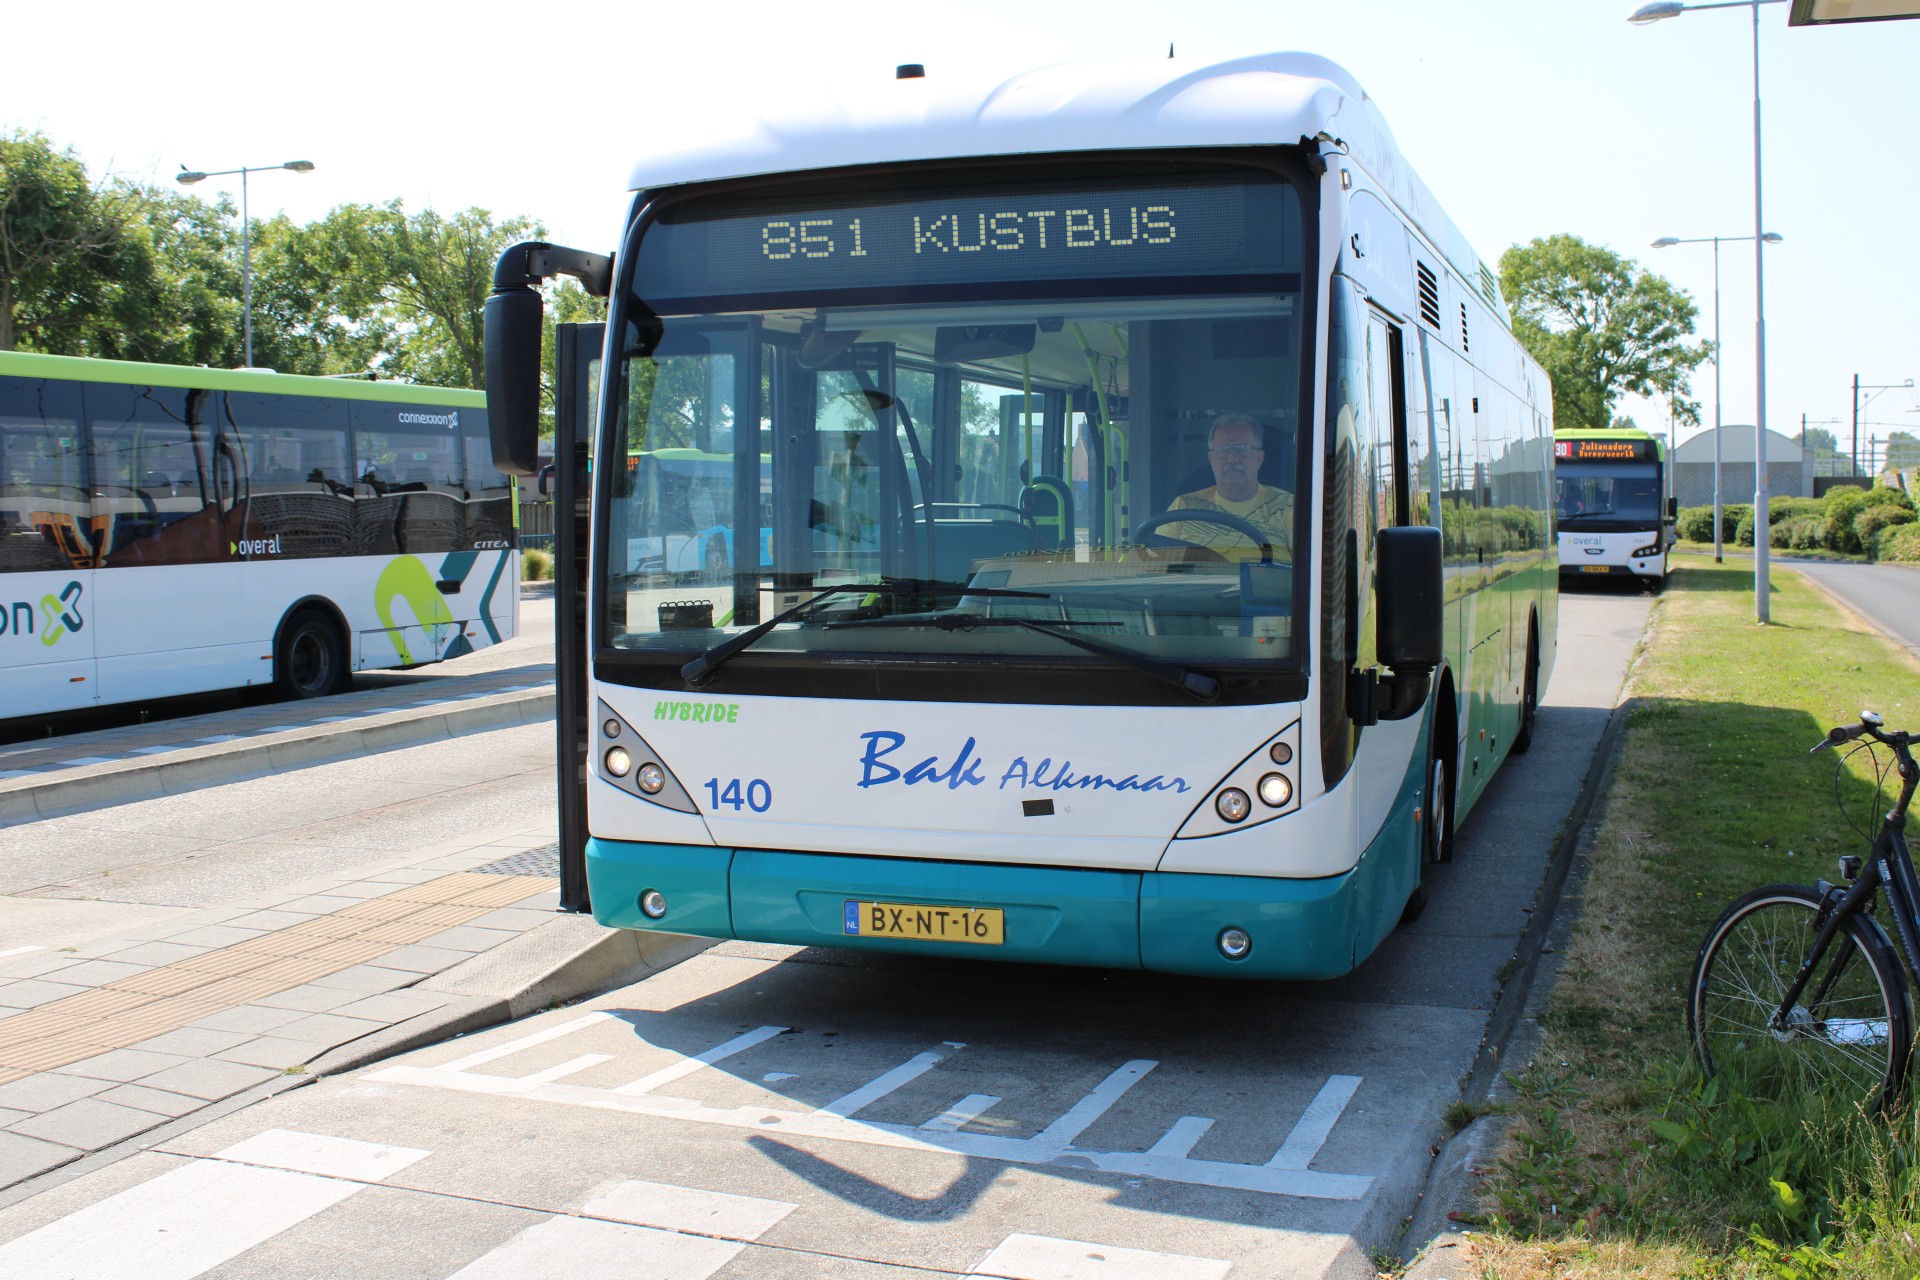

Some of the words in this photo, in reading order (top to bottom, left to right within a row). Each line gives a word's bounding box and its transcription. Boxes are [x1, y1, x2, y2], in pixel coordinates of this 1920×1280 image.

[762, 218, 867, 260] 851
[913, 205, 1177, 255] KUSTBUS
[398, 412, 448, 425] connexxion
[1555, 443, 1567, 456] 30
[238, 533, 281, 555] overal
[473, 540, 509, 549] CITEA
[1573, 536, 1602, 545] overal
[653, 701, 740, 724] HYBRIDE
[856, 730, 986, 790] Bak
[999, 756, 1192, 794] Alkmaar
[703, 777, 773, 813] 140
[846, 920, 858, 930] NL
[871, 907, 988, 938] BX-NT-16
